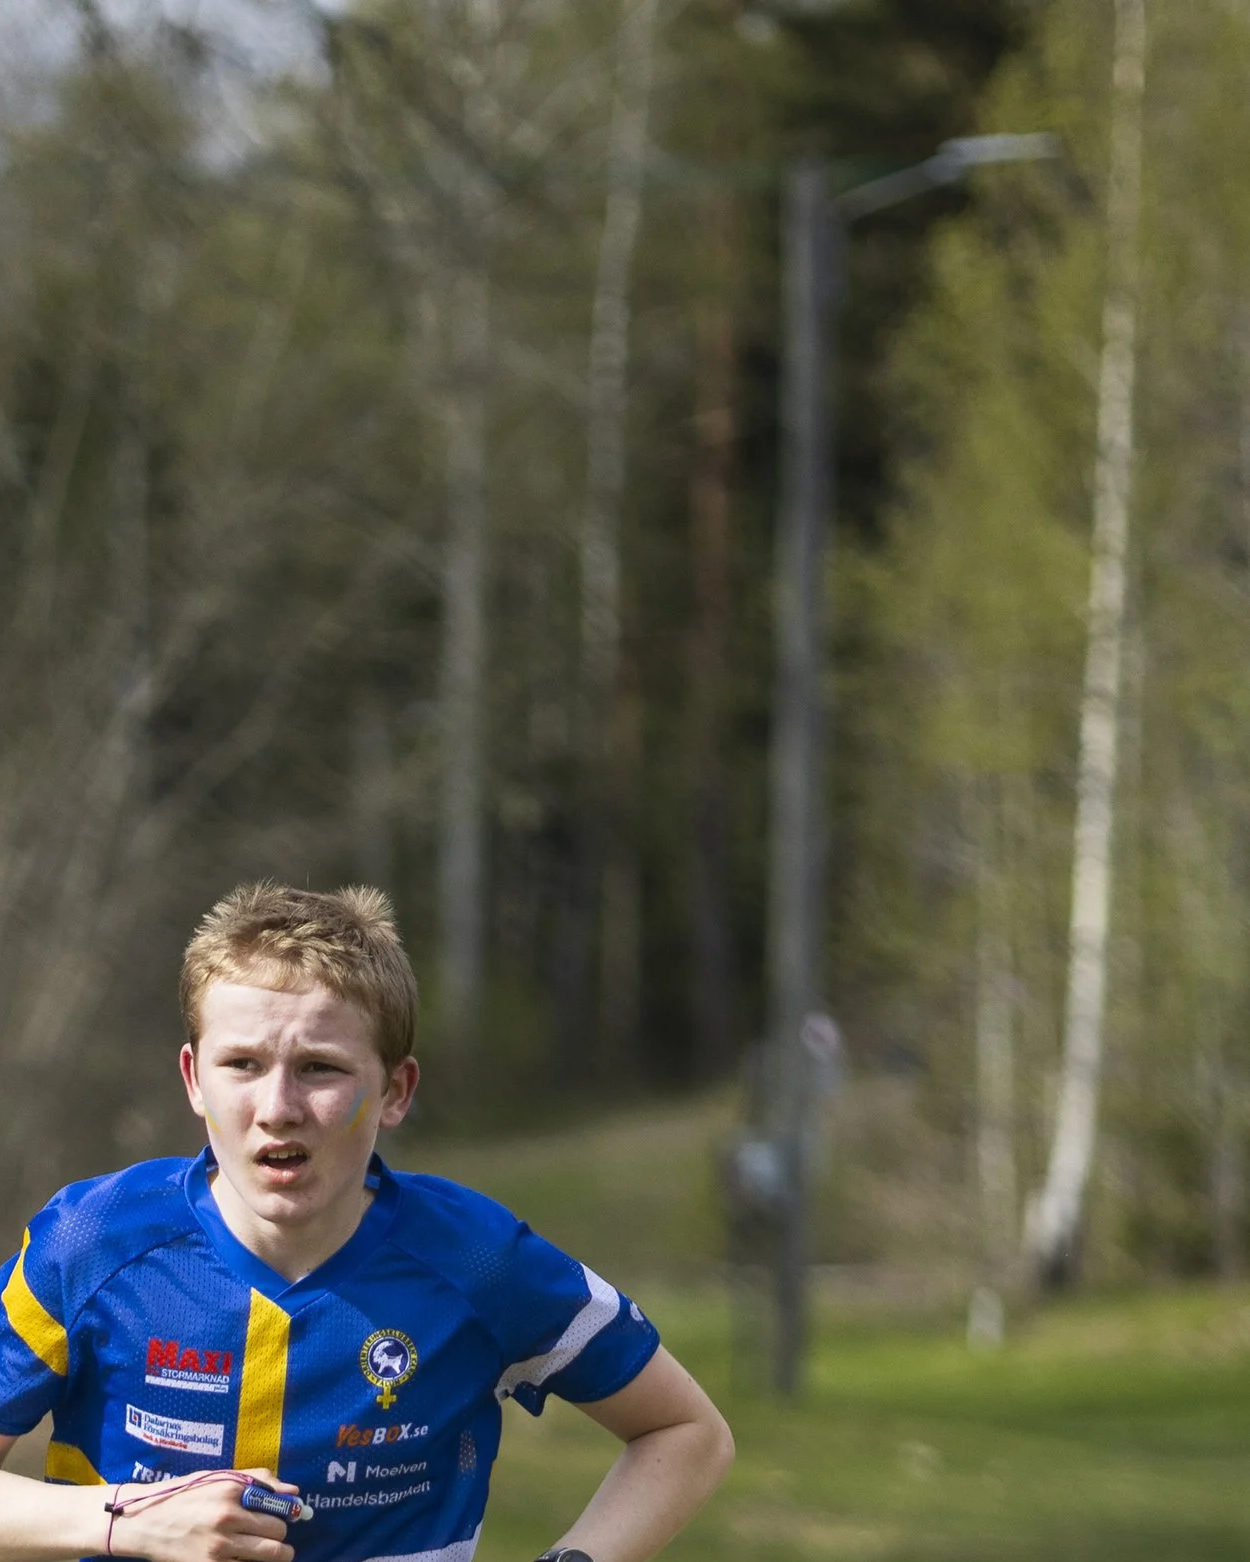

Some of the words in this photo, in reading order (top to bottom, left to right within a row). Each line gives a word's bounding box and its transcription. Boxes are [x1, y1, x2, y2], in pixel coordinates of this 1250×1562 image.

[161, 1368, 230, 1384] STORMARKNAD
[144, 1413, 182, 1431] Dalarnas
[365, 1461, 428, 1478] Moelven
